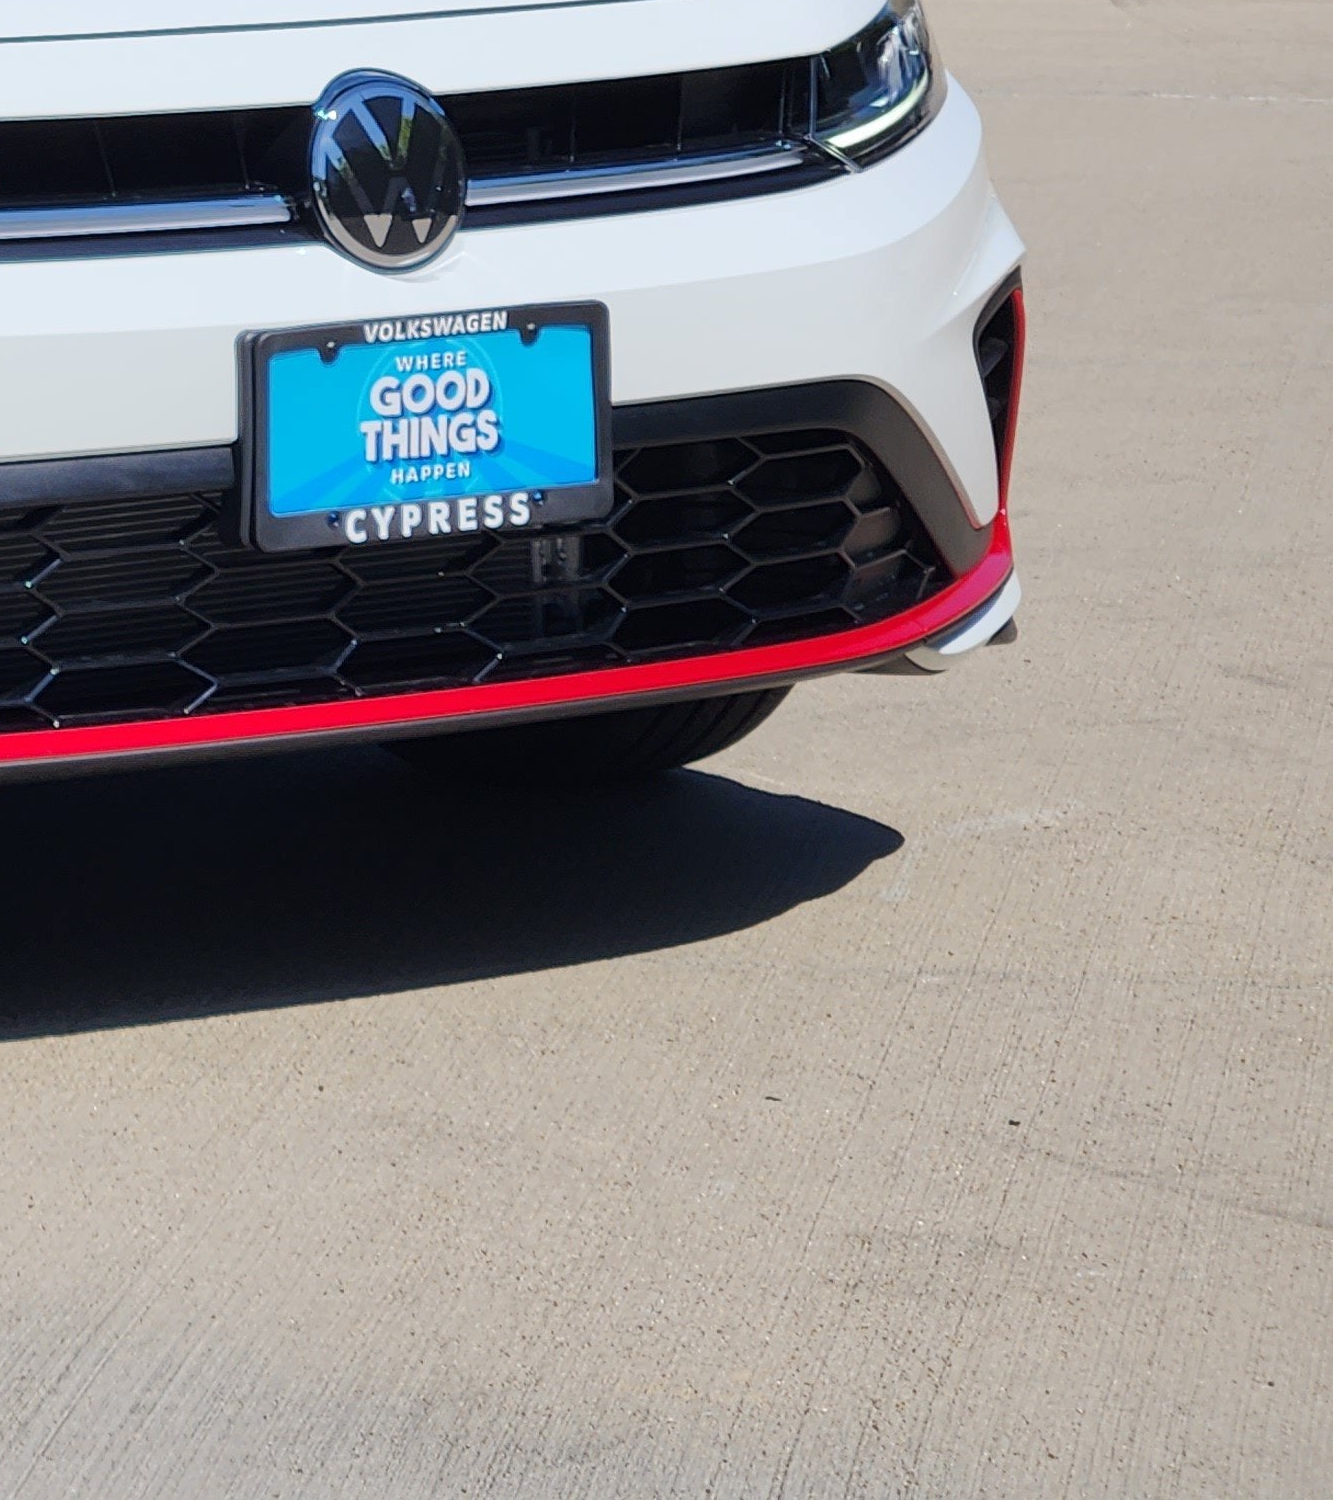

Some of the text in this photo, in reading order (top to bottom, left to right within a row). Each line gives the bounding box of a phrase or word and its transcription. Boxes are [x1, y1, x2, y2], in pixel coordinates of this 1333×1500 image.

[364, 311, 507, 343] VOLKSWAGEN
[396, 351, 467, 372] WHERE
[369, 369, 490, 416] GOOD
[360, 410, 499, 461] THINGS
[391, 462, 471, 484] HAPPEN
[344, 493, 531, 543] CYPRESS
